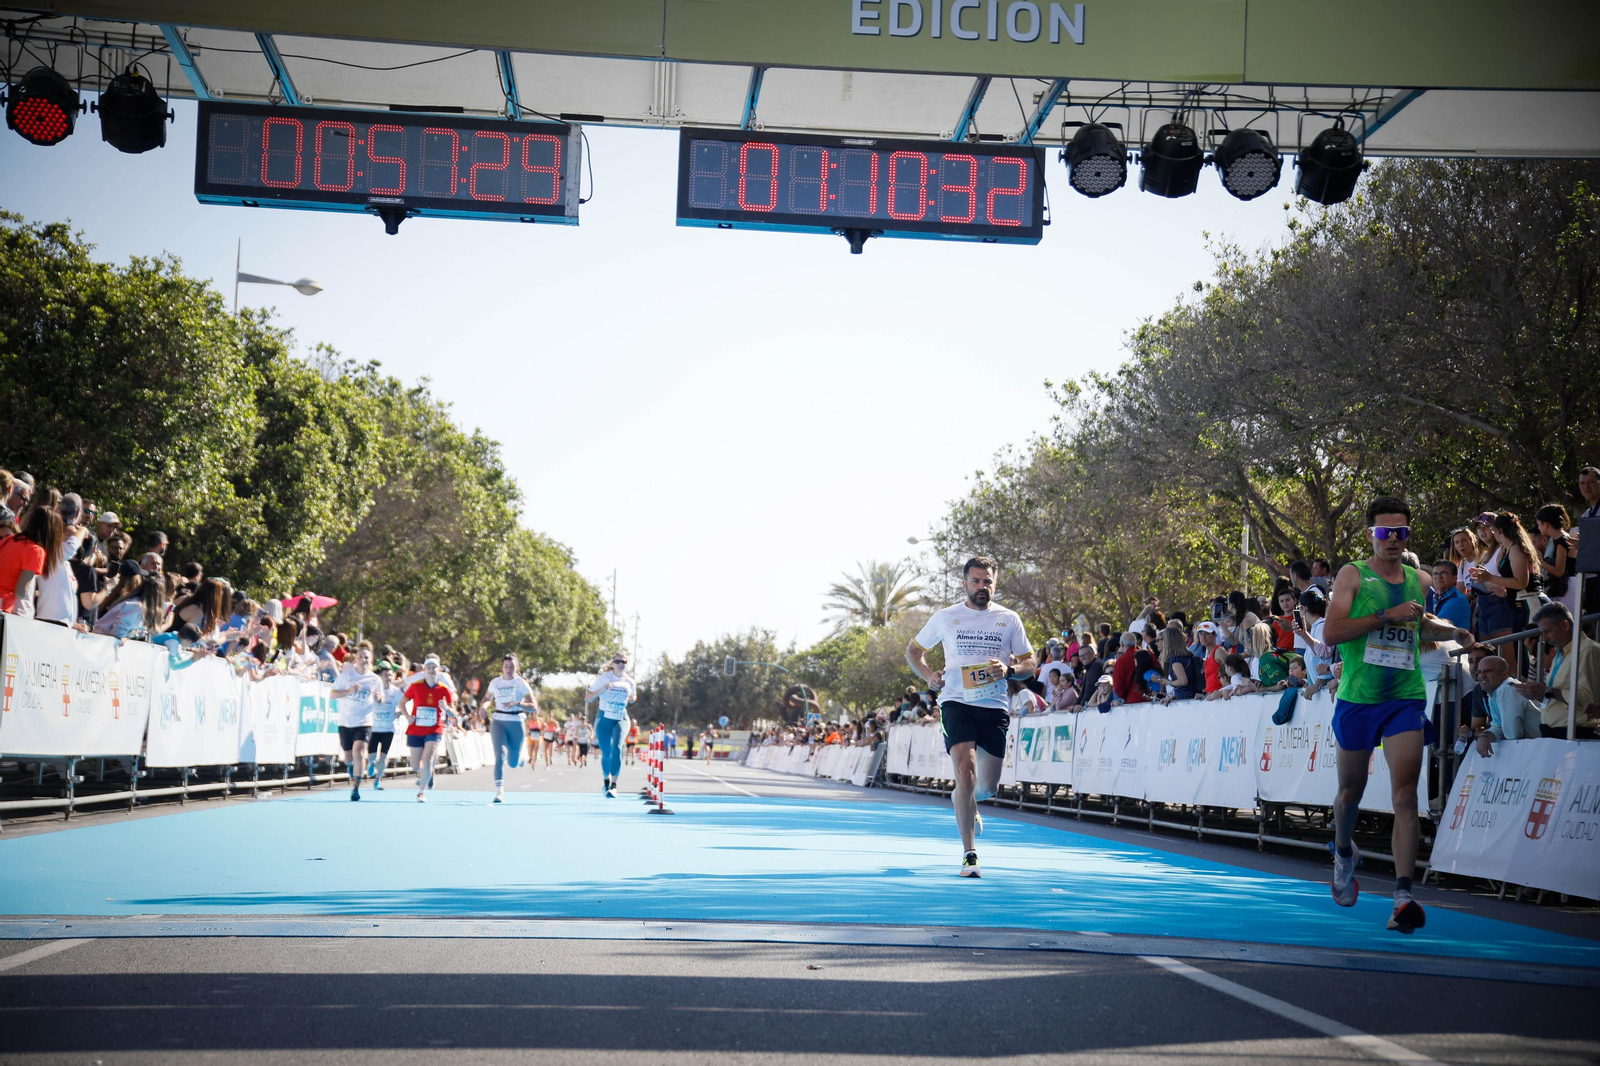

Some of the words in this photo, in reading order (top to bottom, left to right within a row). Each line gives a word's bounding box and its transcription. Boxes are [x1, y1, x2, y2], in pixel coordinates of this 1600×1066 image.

[1377, 625, 1414, 645] 1509
[1278, 721, 1309, 749] ALMERÍA
[1477, 772, 1530, 806] ALMERÍA
[1471, 810, 1498, 828] CIUDAD
[1560, 820, 1599, 841] CIUDAD
